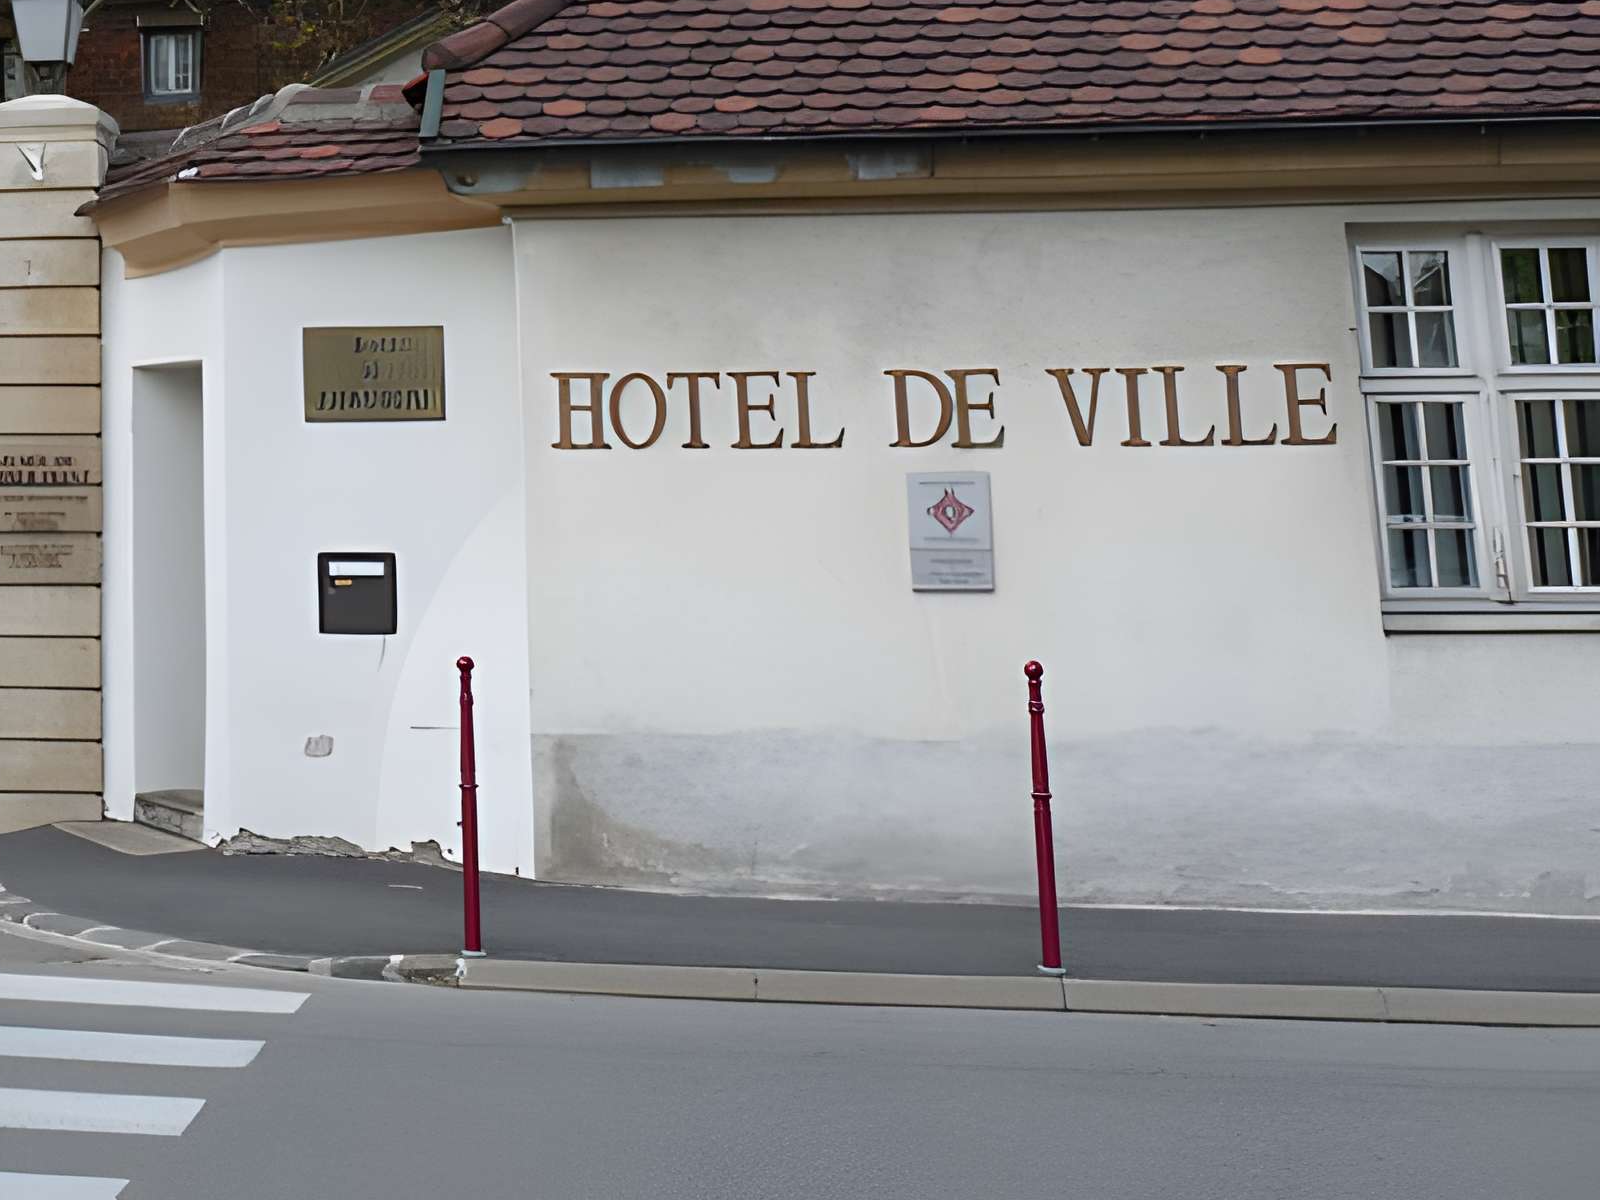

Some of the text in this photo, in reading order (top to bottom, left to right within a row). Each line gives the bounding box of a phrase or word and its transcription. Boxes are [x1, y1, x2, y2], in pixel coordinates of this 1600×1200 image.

[549, 362, 1338, 450] HOTEL DE VILLE
